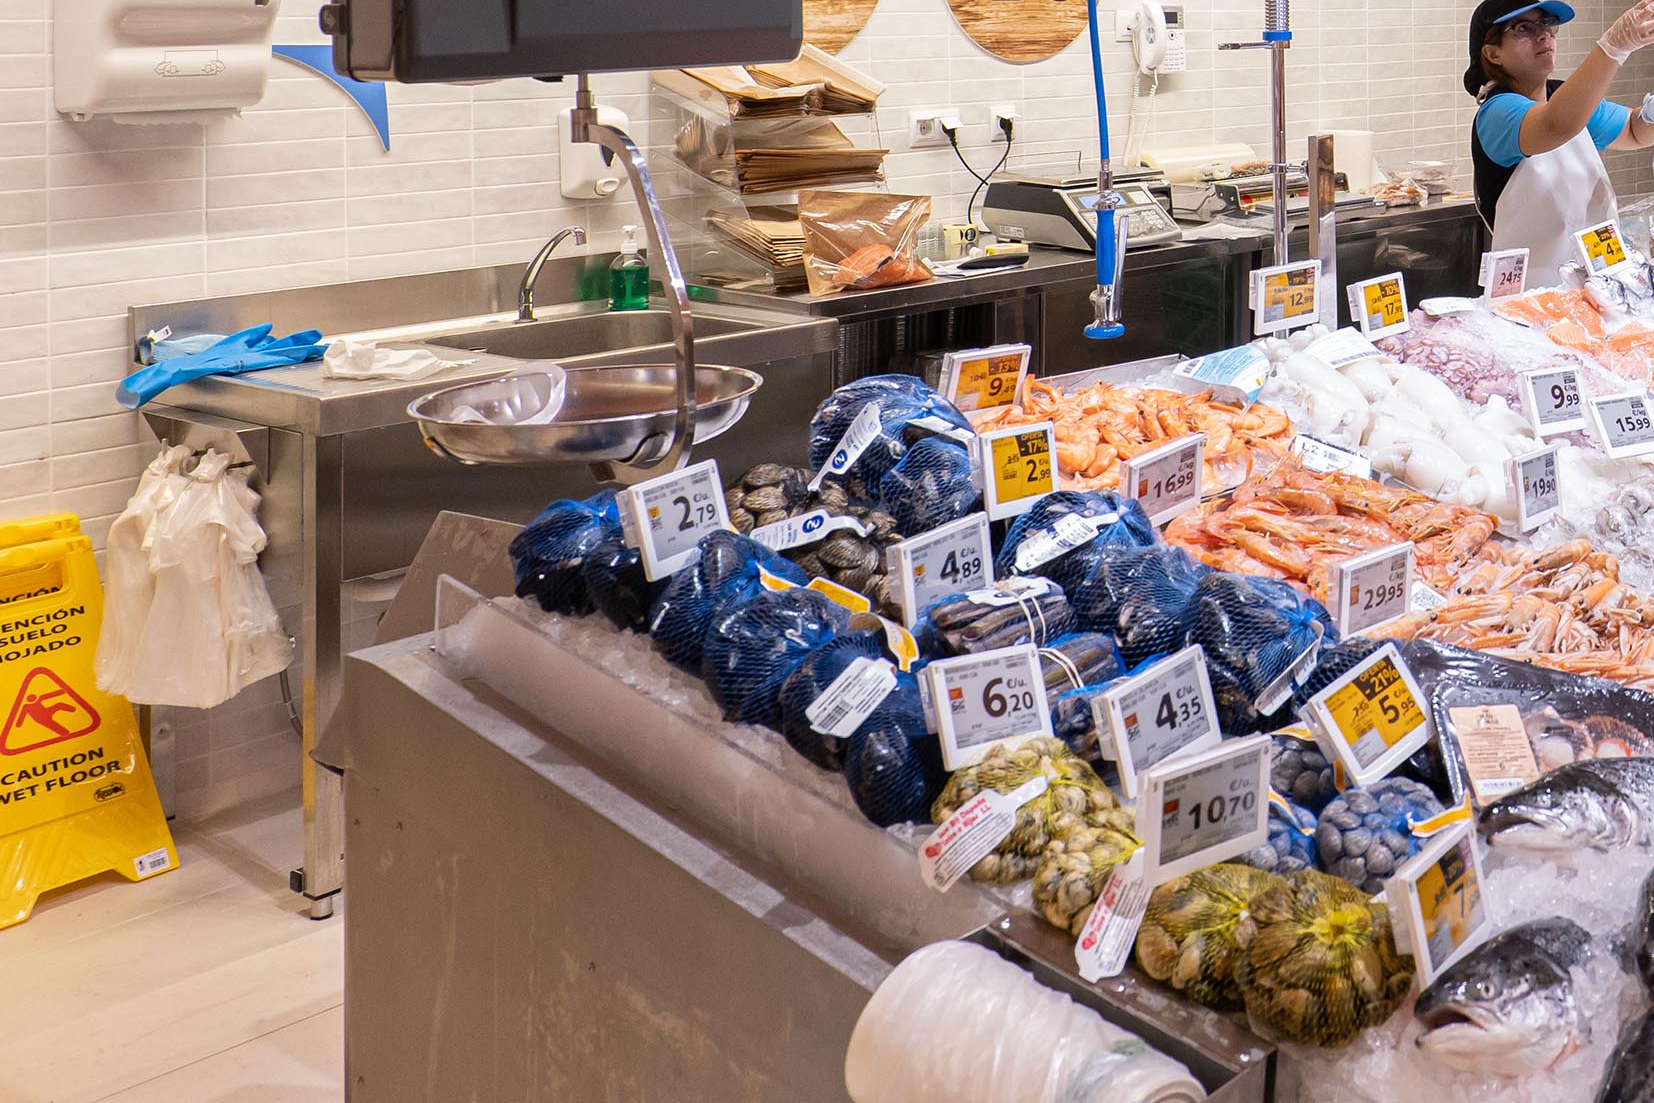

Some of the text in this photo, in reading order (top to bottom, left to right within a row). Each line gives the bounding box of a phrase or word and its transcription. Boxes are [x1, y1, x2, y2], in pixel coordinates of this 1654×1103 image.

[1289, 292, 1313, 307] 12,99
[1550, 384, 1580, 409] 9,99
[1615, 416, 1651, 433] 15,99
[1026, 458, 1052, 483] 2,99
[1153, 471, 1194, 498] 16,99
[672, 495, 716, 532] 2,79
[939, 549, 982, 585] 4,89
[1363, 582, 1404, 611] 29,95
[1, 606, 85, 633] ENCIÓN
[0, 624, 68, 648] SUELO
[1364, 665, 1399, 695] -21%
[982, 677, 1034, 718] 6,20
[1155, 691, 1201, 730] 4,35
[1378, 694, 1416, 725] 5,95
[1, 747, 105, 786] CAUTION
[45, 760, 121, 792] FLOOR
[1188, 790, 1256, 830] 10,70
